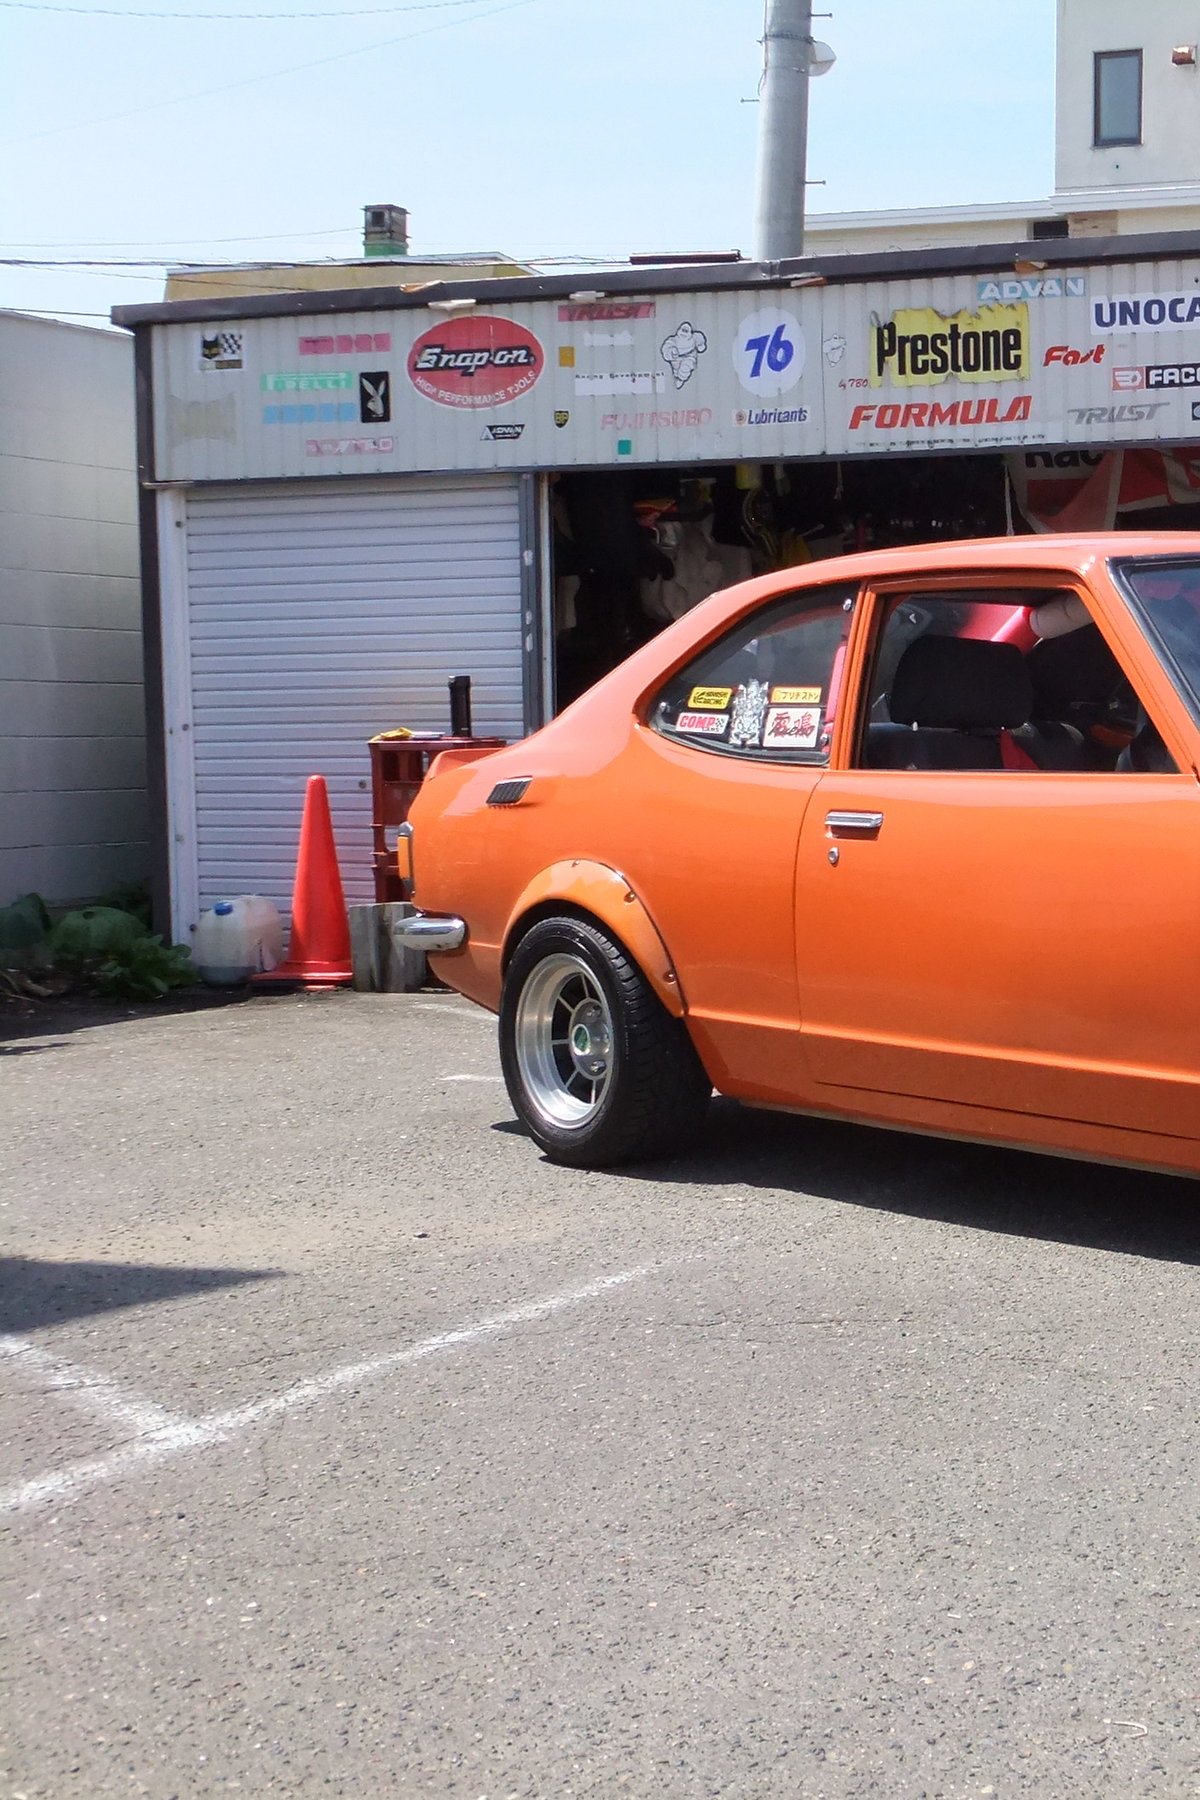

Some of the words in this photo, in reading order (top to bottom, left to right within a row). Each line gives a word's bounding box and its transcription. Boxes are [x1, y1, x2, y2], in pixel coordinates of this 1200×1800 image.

[980, 277, 1085, 299] ADVAN
[416, 347, 529, 373] Snap-on
[744, 323, 794, 378] 76
[876, 321, 1023, 377] Prestone
[555, 411, 569, 425] BP
[747, 407, 808, 424] Lubricants
[848, 395, 1033, 429] FORMULA
[1066, 402, 1171, 425] TRUST
[679, 715, 716, 729] COMP
